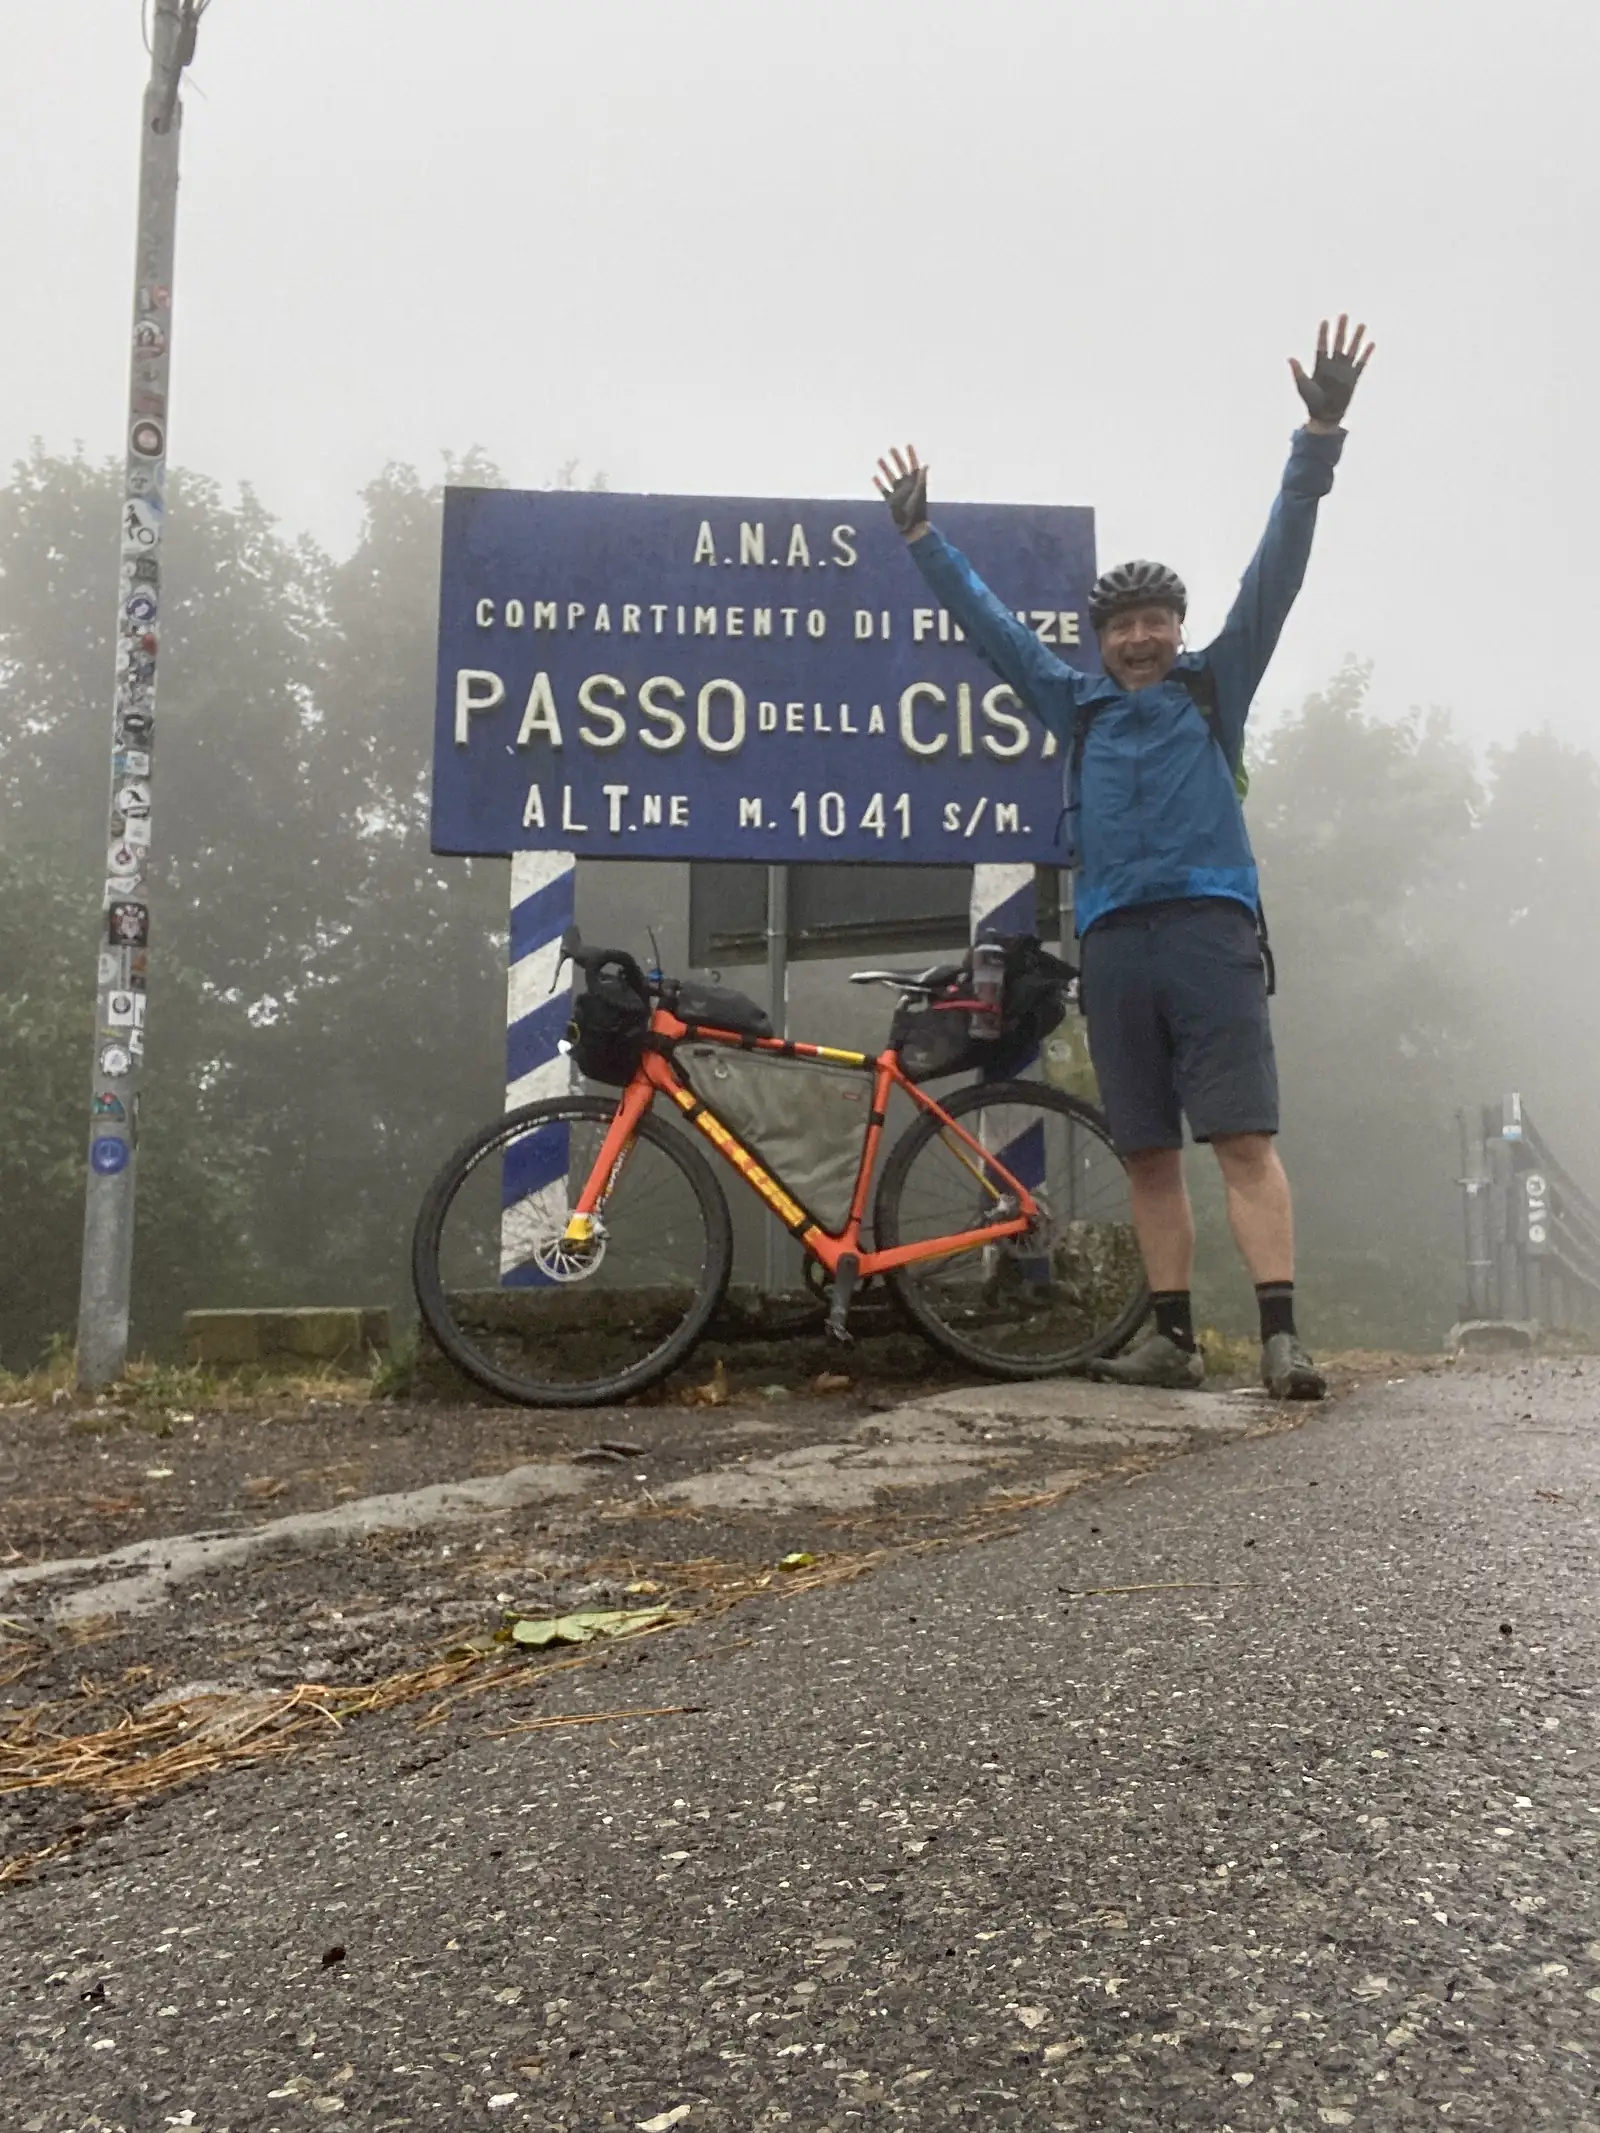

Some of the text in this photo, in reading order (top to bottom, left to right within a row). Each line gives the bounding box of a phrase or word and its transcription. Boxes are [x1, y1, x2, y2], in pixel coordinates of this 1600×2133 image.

[693, 520, 858, 567] A.N.A.S
[475, 598, 1081, 645] COMPARTIMENTO DI FIZE
[455, 668, 1058, 758] PASSO DELLA CIS
